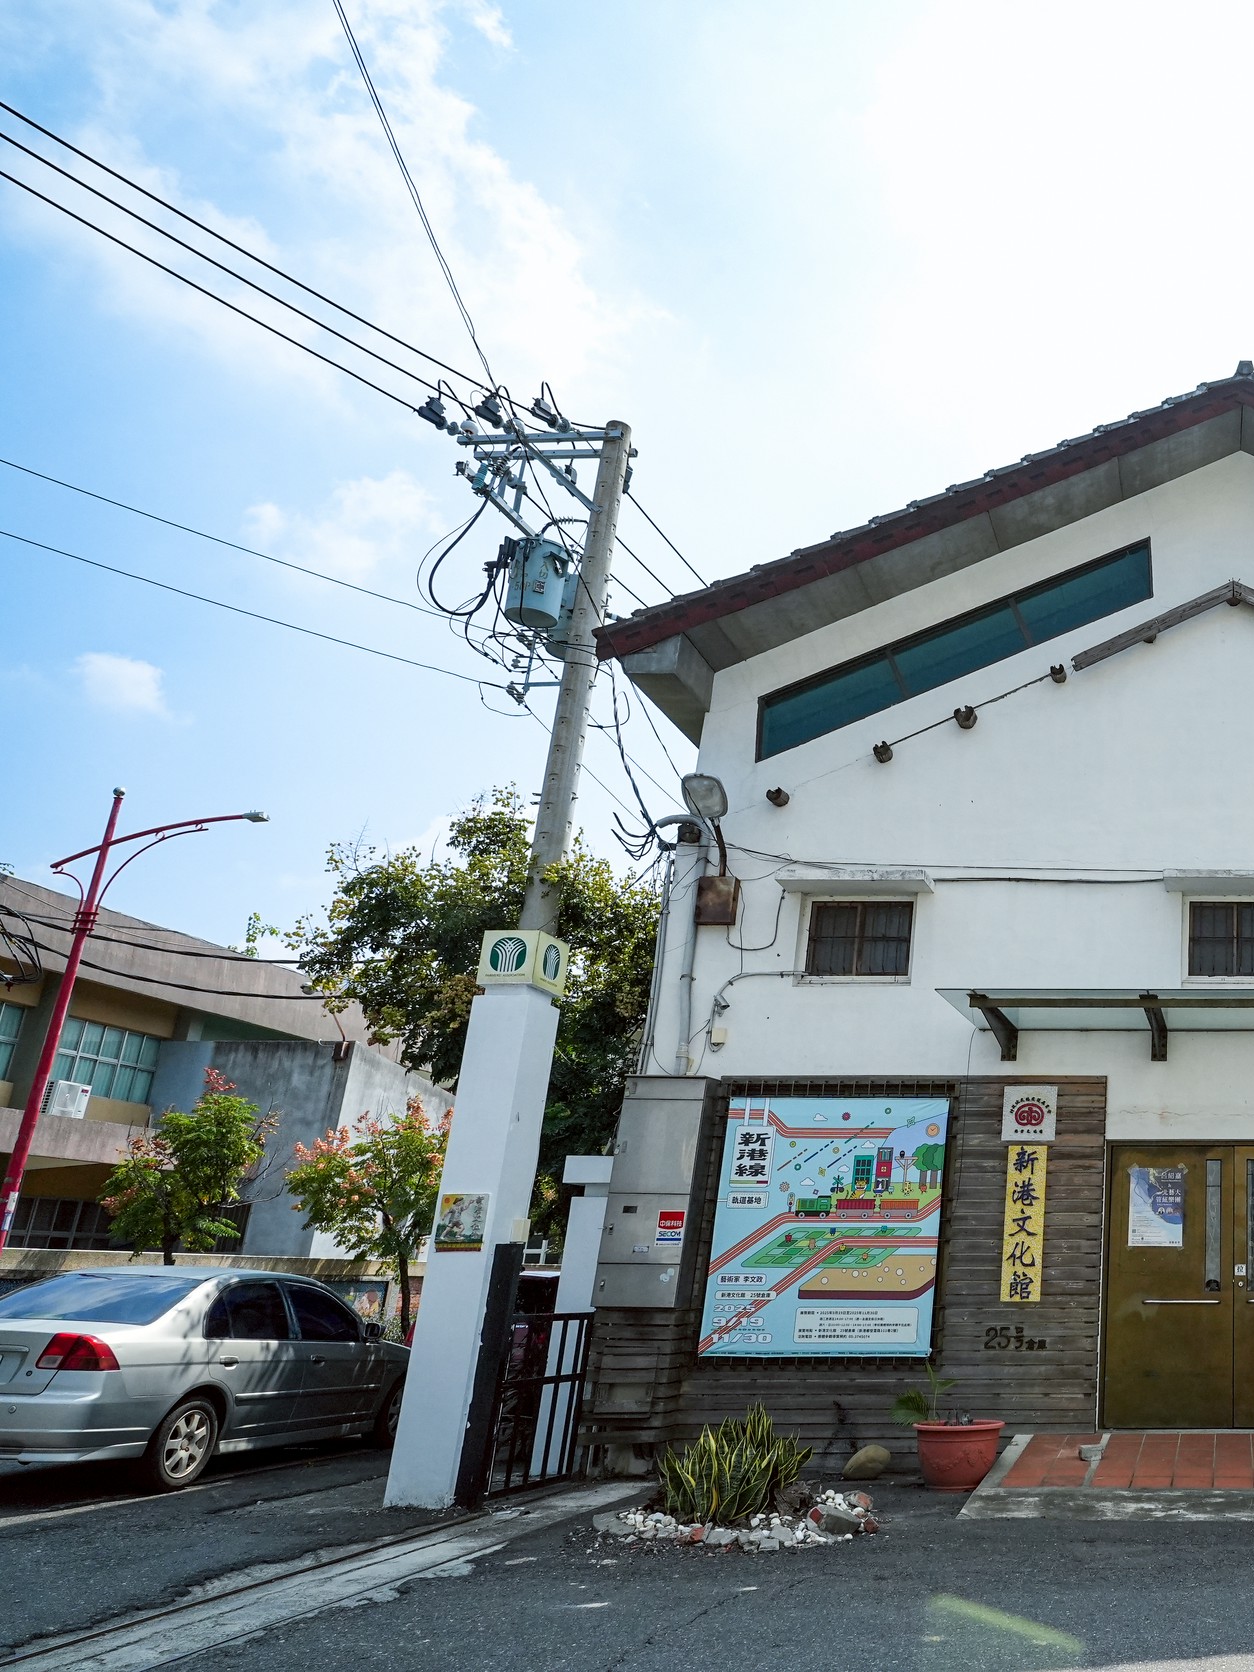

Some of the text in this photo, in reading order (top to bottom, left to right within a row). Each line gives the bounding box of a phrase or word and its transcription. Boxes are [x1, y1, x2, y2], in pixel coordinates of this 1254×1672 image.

[735, 1132, 771, 1177] 新港線
[731, 1196, 762, 1205] 軌道基地
[1006, 1146, 1040, 1300] 新港文化館
[720, 1275, 764, 1283] 藝術家 李文政
[714, 1304, 756, 1312] 2025
[712, 1316, 765, 1327] 9/19
[711, 1333, 773, 1343] 11/30
